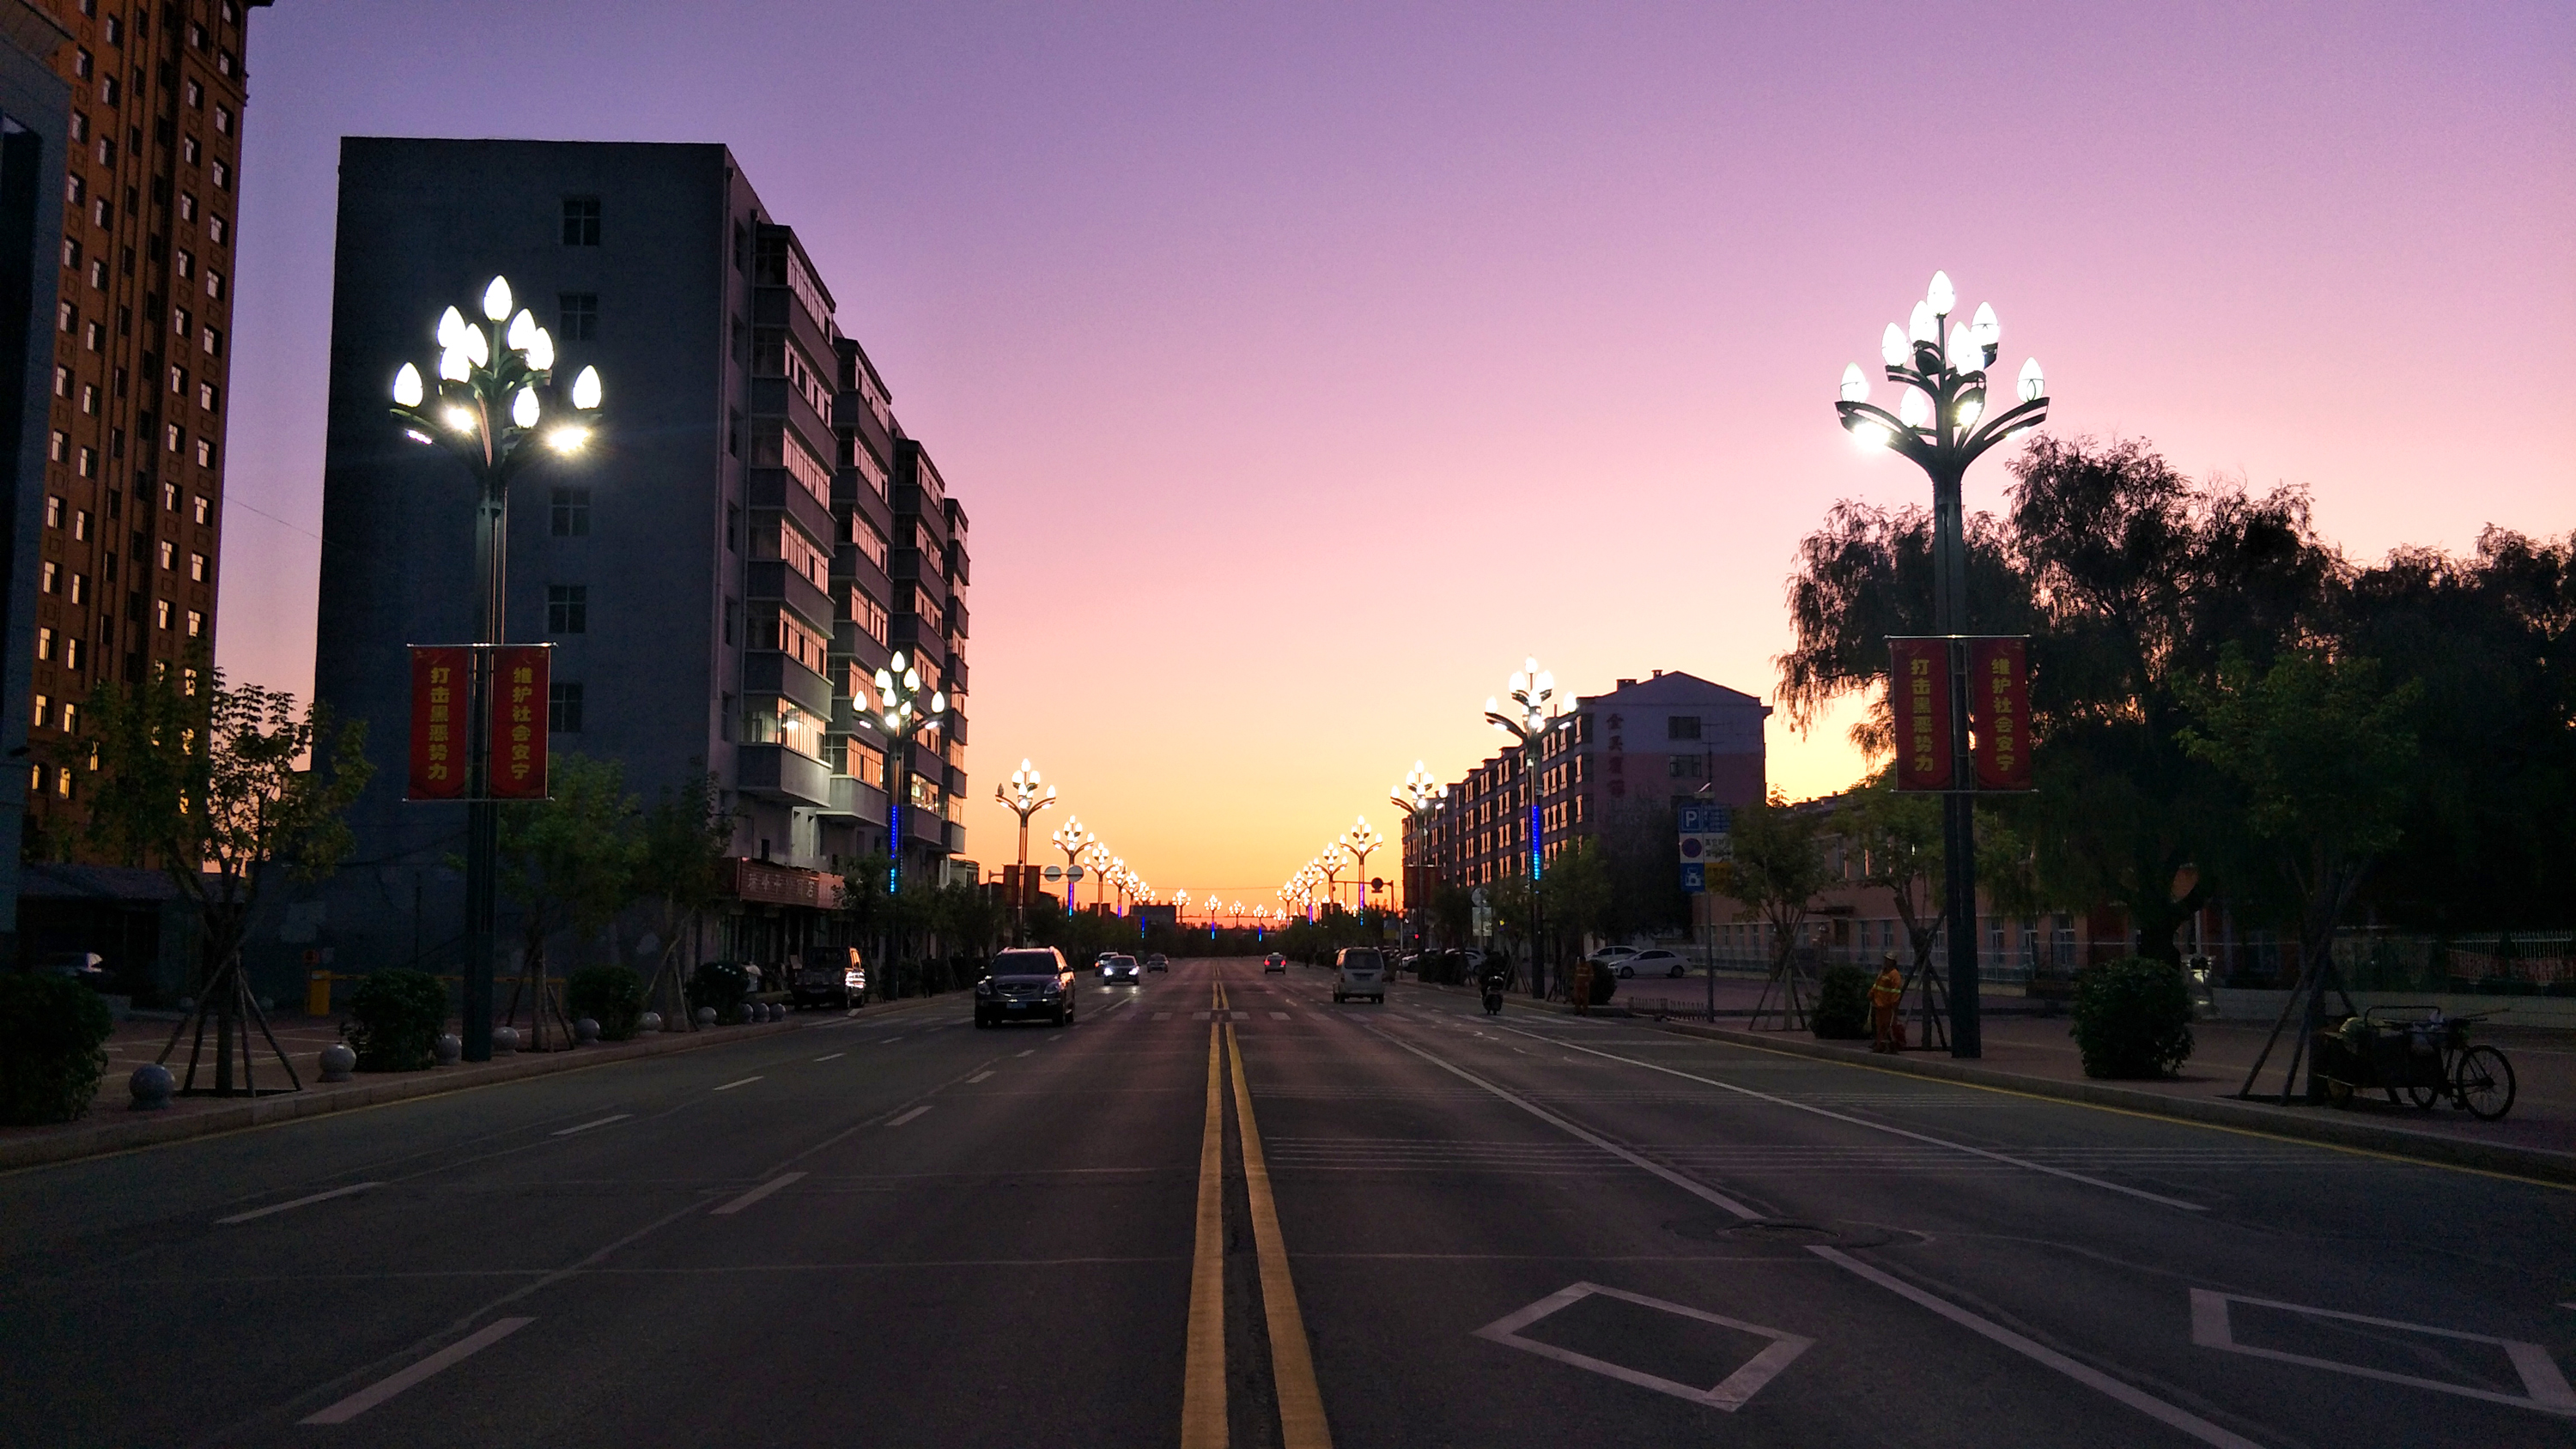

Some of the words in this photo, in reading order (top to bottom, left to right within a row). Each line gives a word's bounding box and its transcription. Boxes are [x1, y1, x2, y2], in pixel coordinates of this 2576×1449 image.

[428, 666, 451, 780] 打击黑恶势力
[511, 666, 533, 780] 维护社会安宁
[1911, 658, 1934, 772] 打击黑恶势力
[1990, 658, 2014, 772] 维护社会安宁
[1685, 810, 1698, 828] P
